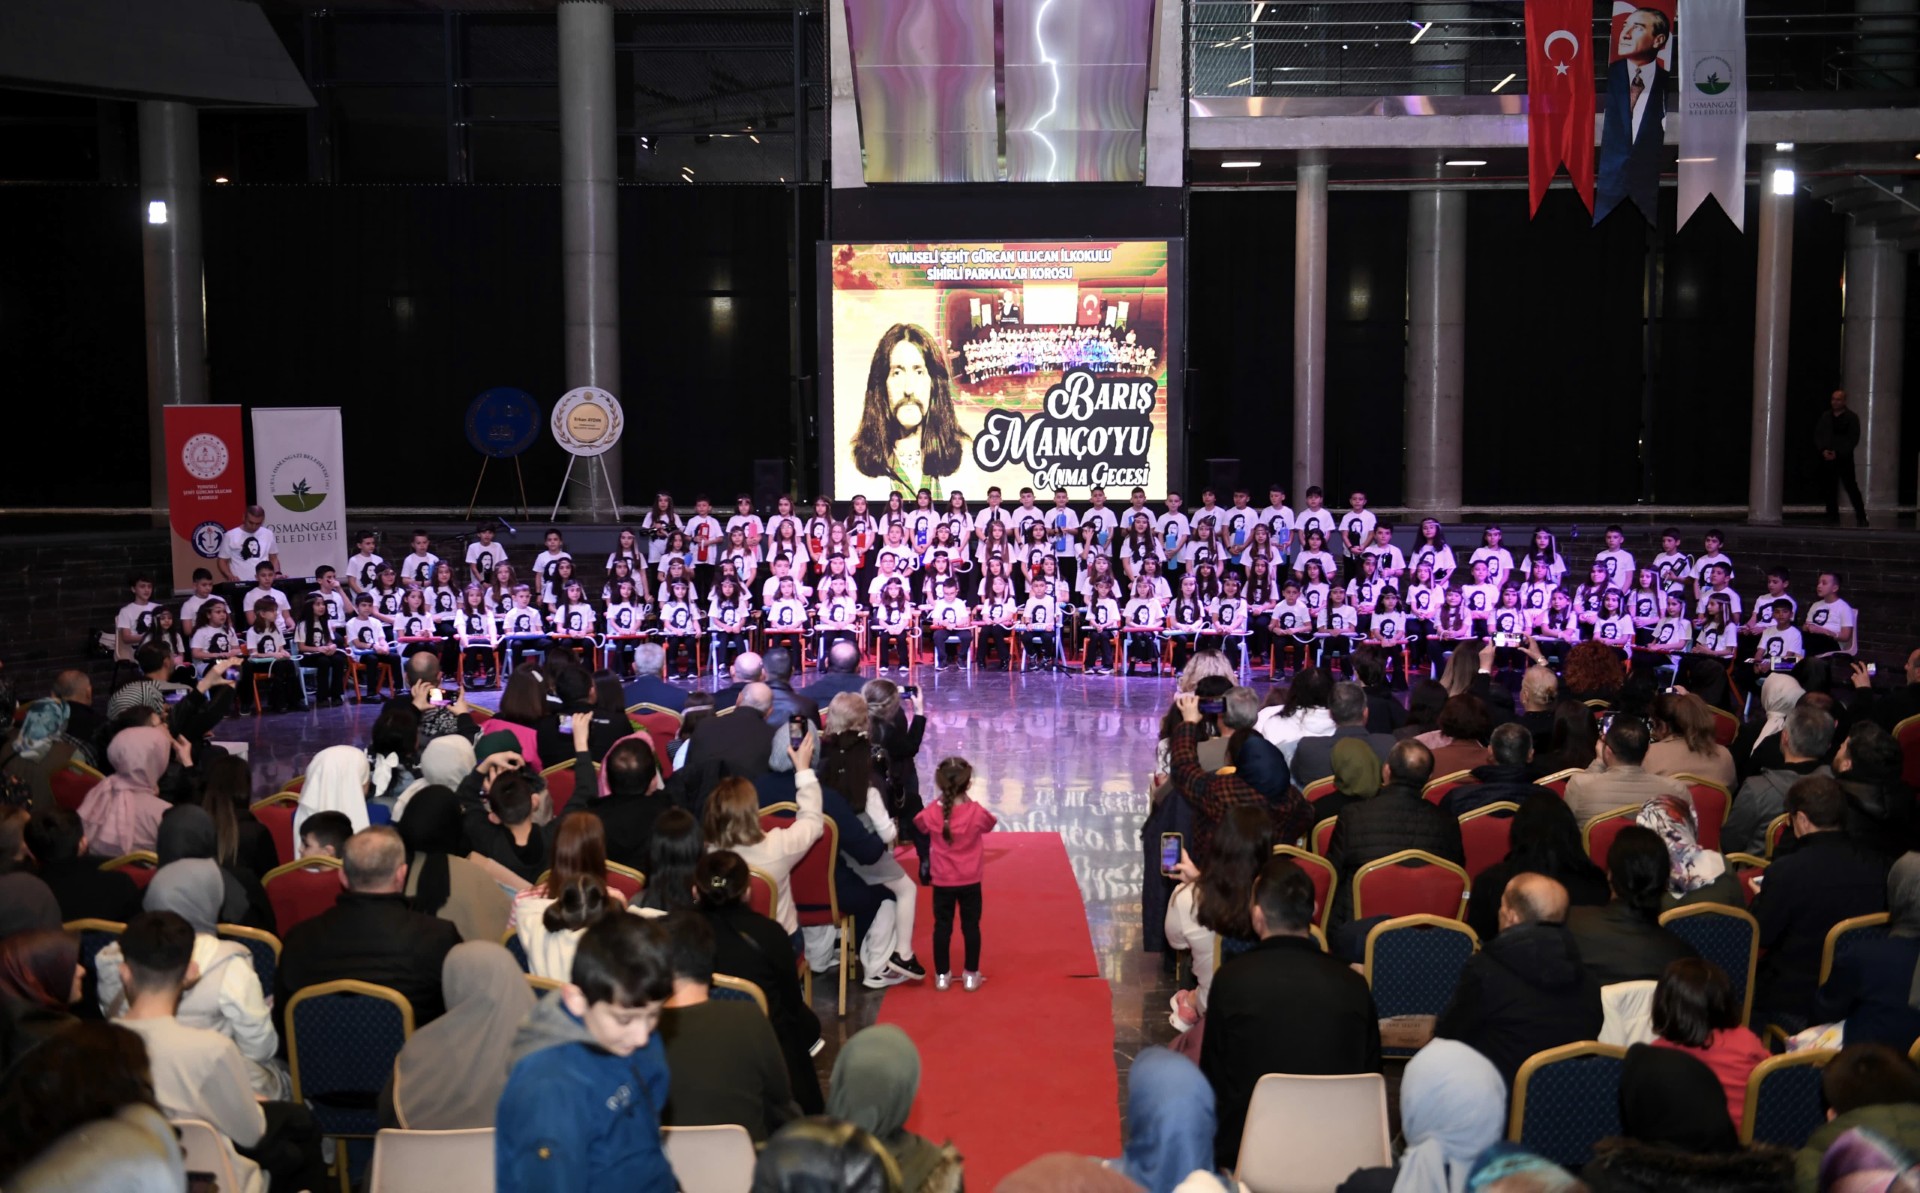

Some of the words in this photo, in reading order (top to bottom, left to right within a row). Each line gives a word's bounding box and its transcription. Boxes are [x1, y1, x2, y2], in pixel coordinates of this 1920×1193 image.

[1689, 100, 1737, 109] OSMANGAZİ
[888, 249, 939, 264] YUNUSELİ
[940, 249, 970, 265] ŞEHİT
[971, 248, 1015, 263] GÜRCAN
[1016, 250, 1059, 263] ULUCAN
[1060, 248, 1112, 262] İLKOKULU
[927, 266, 964, 281] SİHİRLİ
[964, 268, 1028, 280] PARMAKLAR
[1029, 267, 1073, 280] KOROSU
[1047, 371, 1154, 421] BARIŞ
[1034, 462, 1088, 491] ANMA
[266, 520, 337, 533] OSMANGAZİ
[275, 532, 338, 544] ELEDİYESİ
